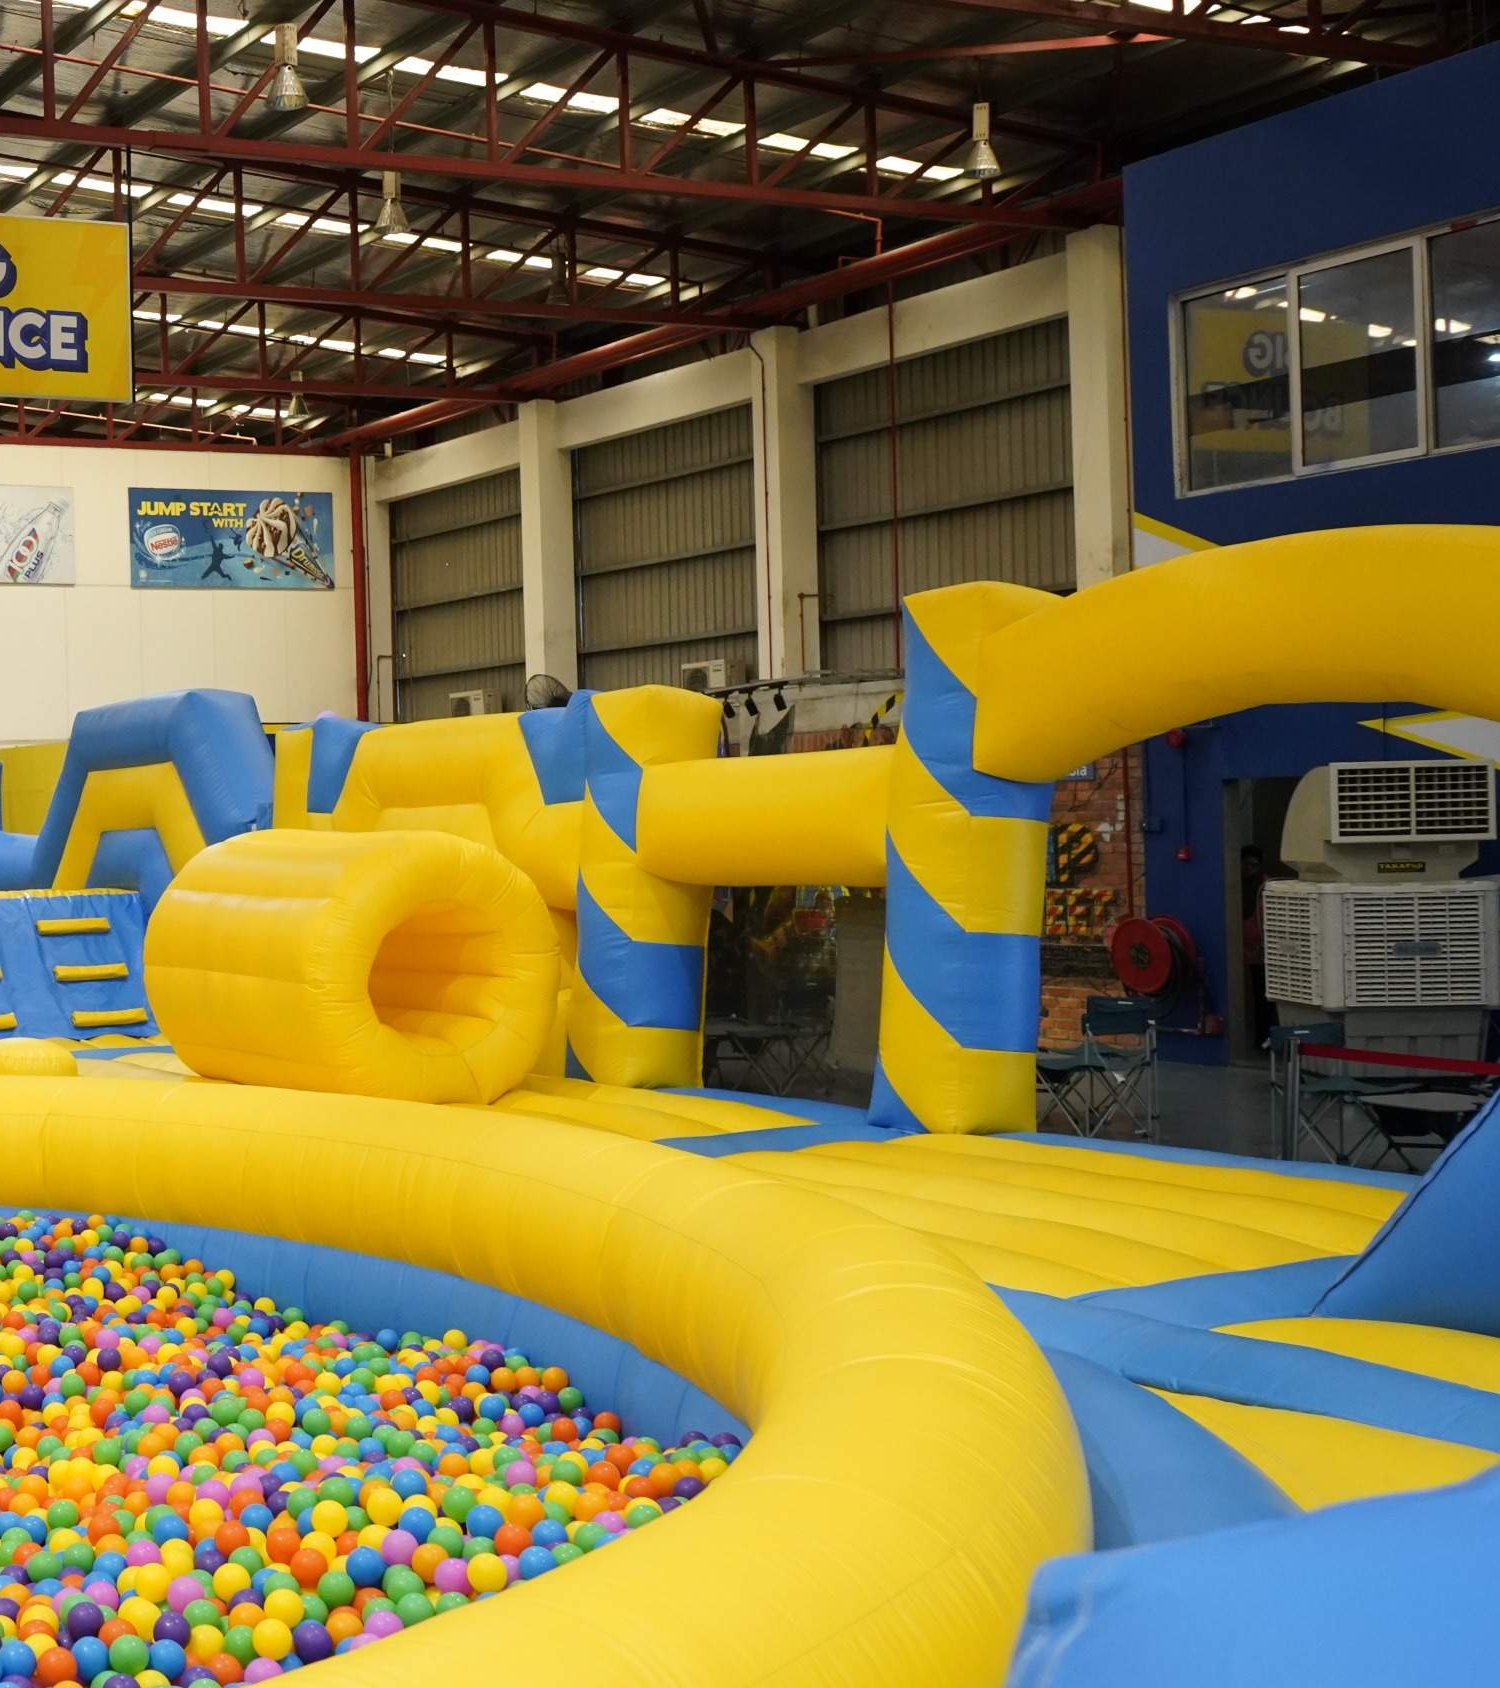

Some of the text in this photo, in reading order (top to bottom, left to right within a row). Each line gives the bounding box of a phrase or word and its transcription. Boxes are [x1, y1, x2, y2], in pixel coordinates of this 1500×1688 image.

[137, 501, 246, 517] JUMP START
[212, 518, 243, 528] WITH
[24, 550, 44, 579] PLUS
